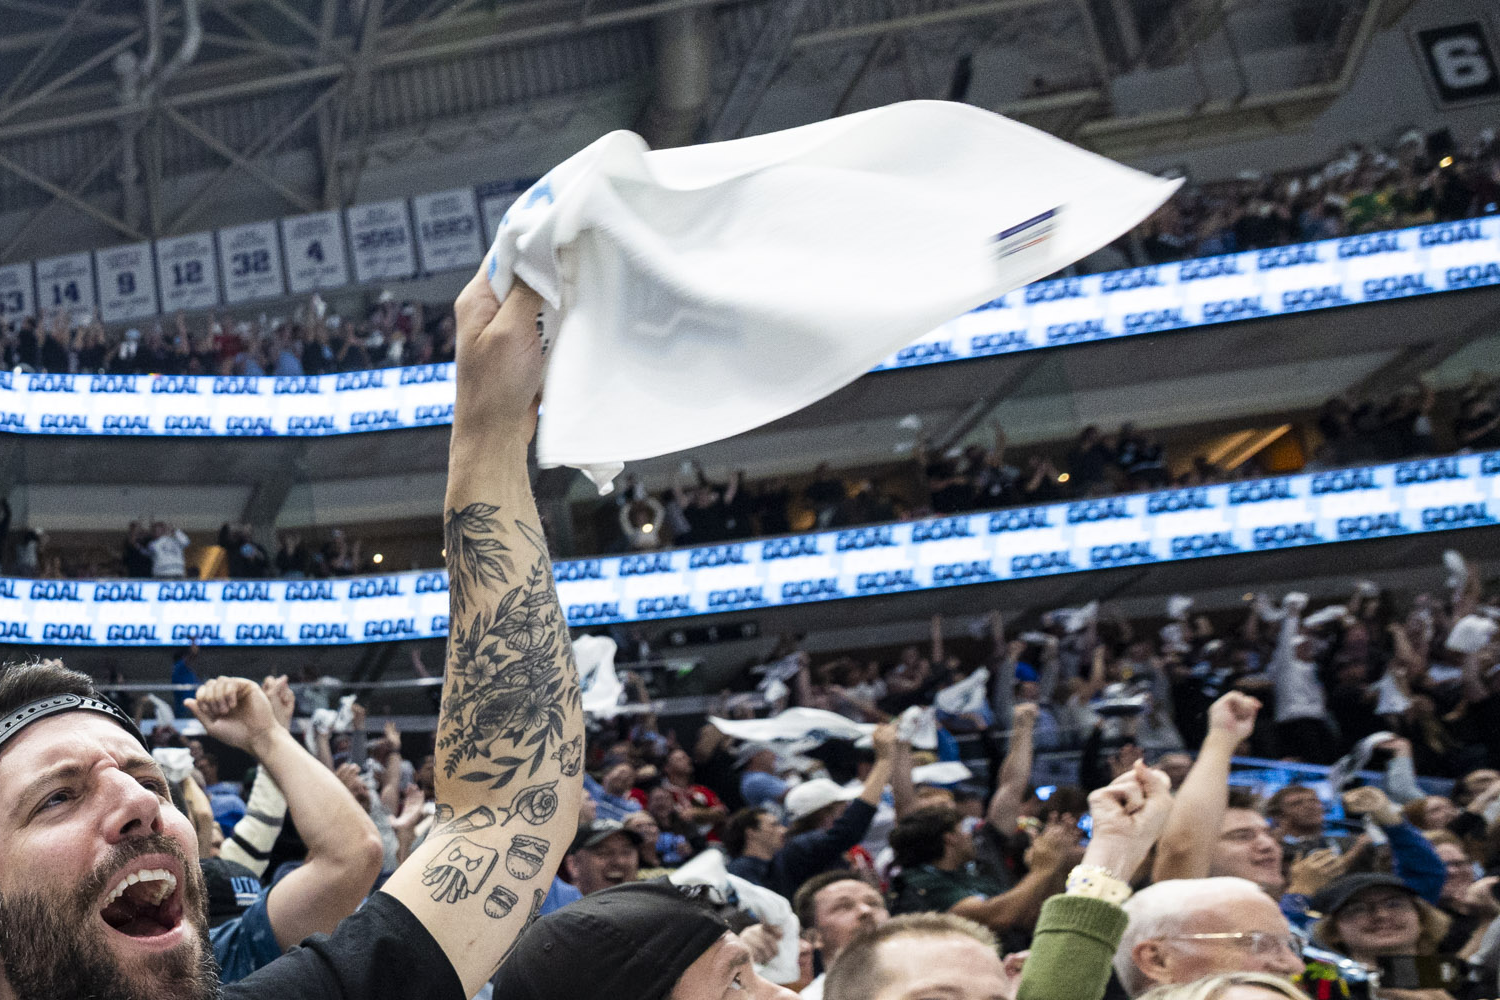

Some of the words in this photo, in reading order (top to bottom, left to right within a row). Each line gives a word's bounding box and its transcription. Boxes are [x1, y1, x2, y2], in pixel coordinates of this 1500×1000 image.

[1445, 261, 1500, 284] GOA
[39, 415, 89, 428] GOAL
[102, 416, 151, 429] GOAL
[164, 417, 213, 430] GOAL
[225, 418, 274, 430] GOAL
[286, 417, 336, 430] GOAL
[349, 411, 400, 425] GOAL
[415, 403, 455, 421] GOA
[29, 584, 85, 601] GOAL
[92, 585, 149, 602] GOAL
[157, 585, 213, 602] GOAL
[220, 585, 276, 602] GOAL
[284, 584, 339, 601] GOAL
[347, 580, 405, 599] GOAL
[41, 624, 97, 640] GOAL
[106, 625, 162, 640] GOAL
[170, 625, 223, 640] GOAL
[234, 625, 287, 640] GOAL
[298, 624, 350, 639] GOAL
[363, 619, 421, 636] GOAL
